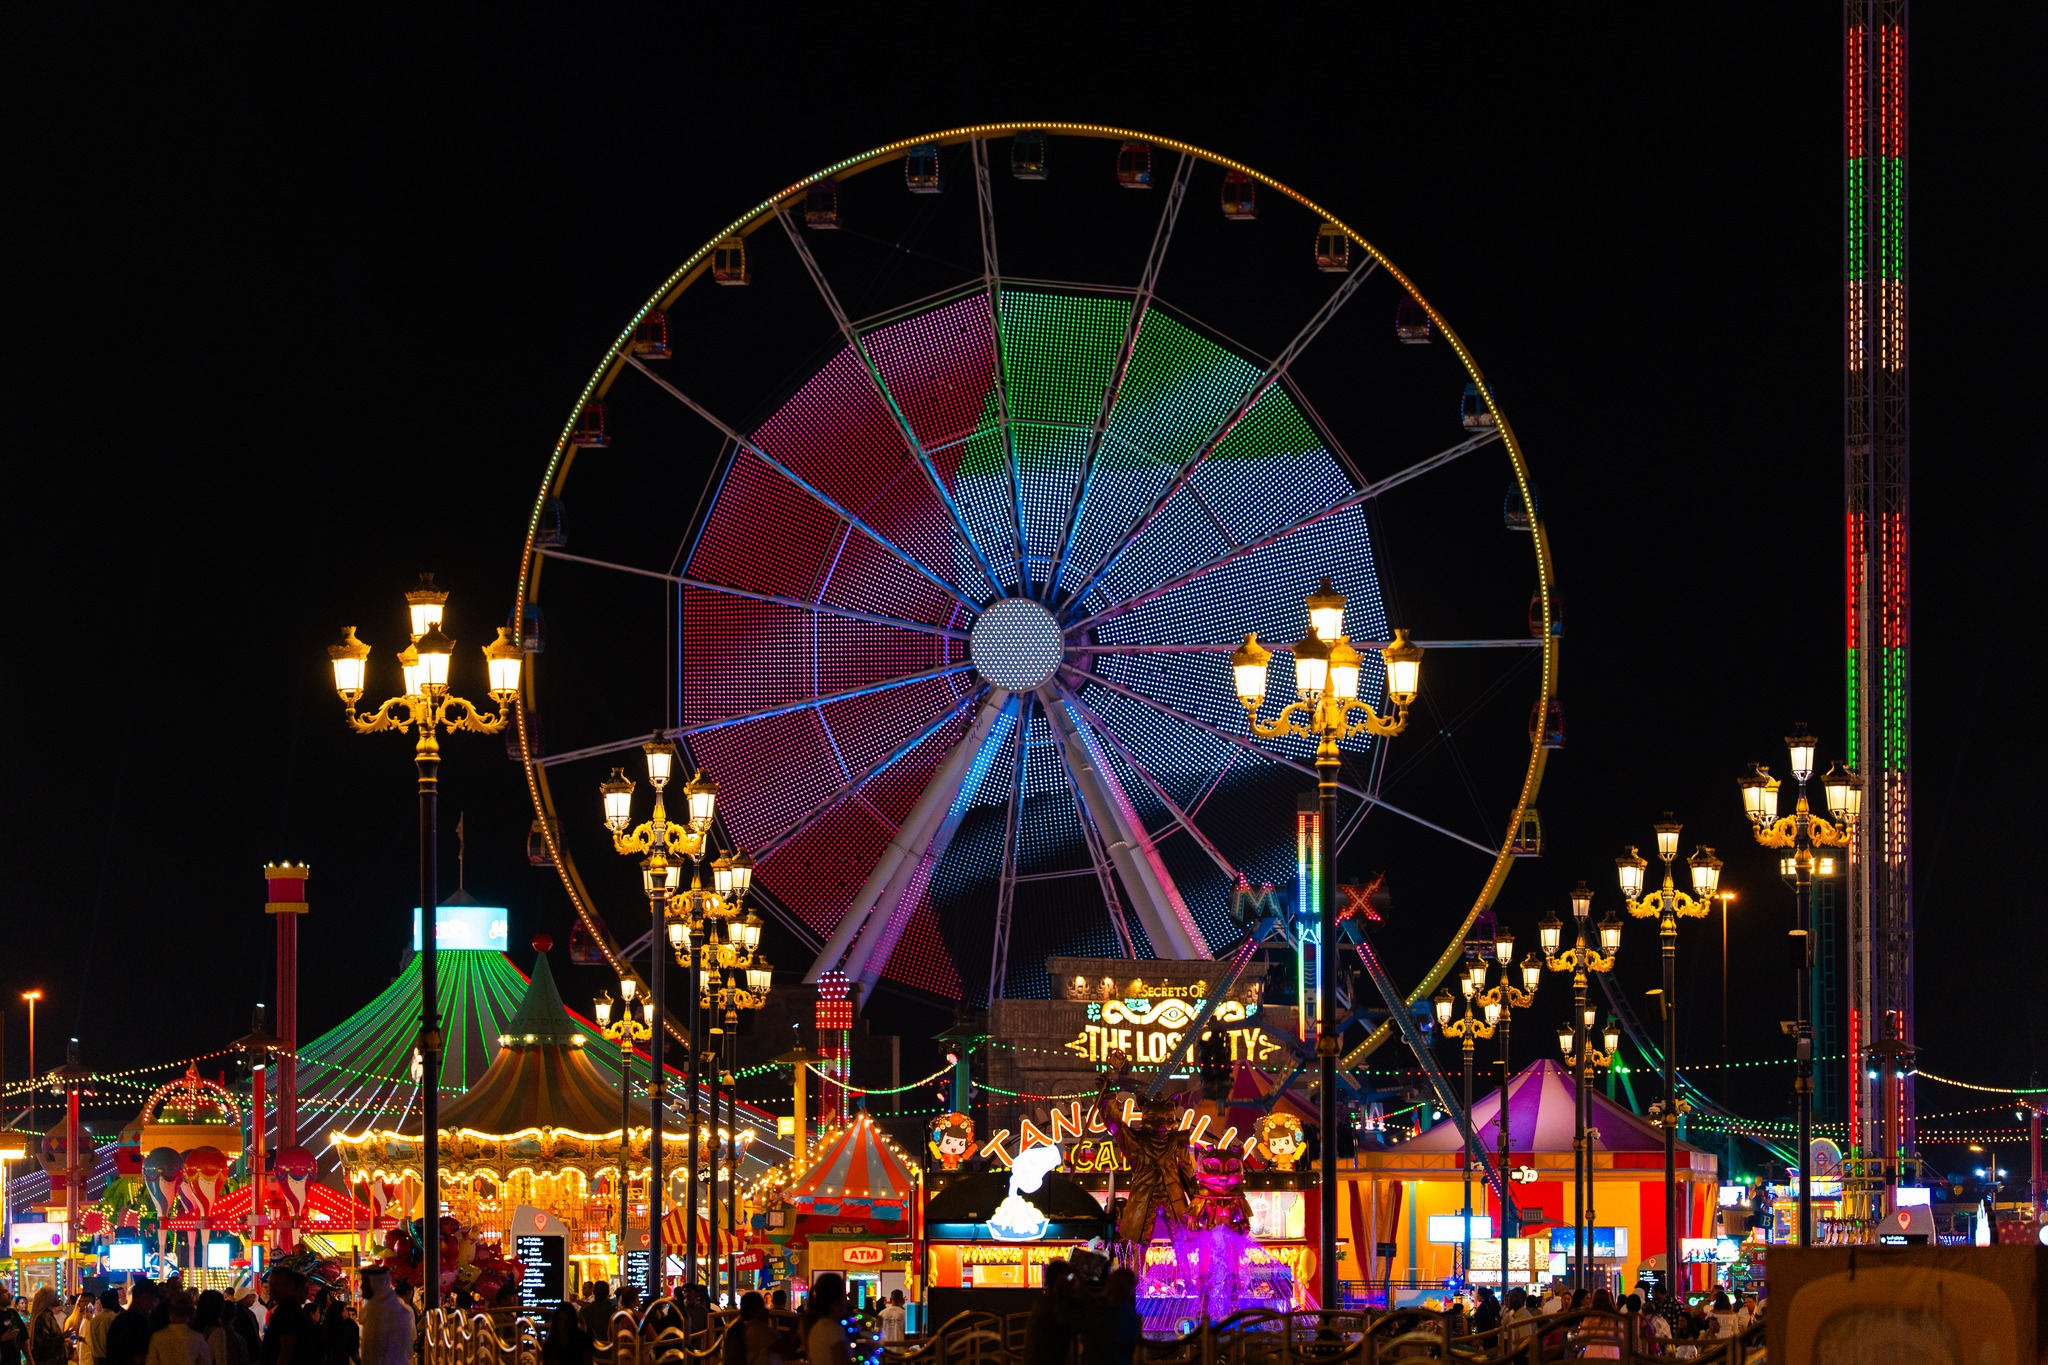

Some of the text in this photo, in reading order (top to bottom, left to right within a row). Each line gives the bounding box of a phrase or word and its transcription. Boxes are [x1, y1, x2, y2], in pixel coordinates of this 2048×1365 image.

[1141, 984, 1188, 998] SECRETS
[1085, 1024, 1133, 1063] THE
[832, 1226, 851, 1234] ROLL
[735, 1254, 758, 1267] ZONE
[849, 1250, 878, 1260] ATM
